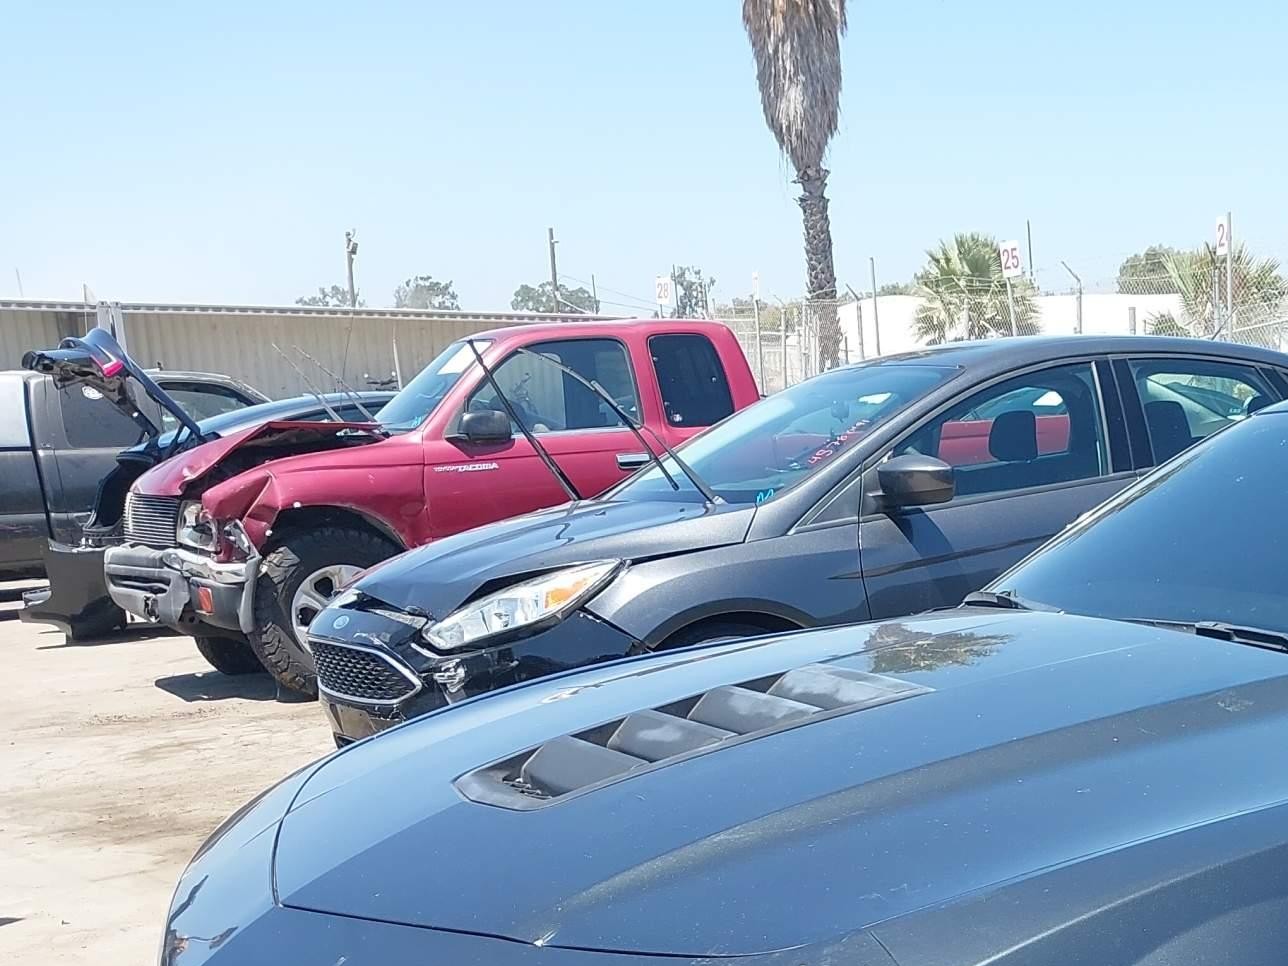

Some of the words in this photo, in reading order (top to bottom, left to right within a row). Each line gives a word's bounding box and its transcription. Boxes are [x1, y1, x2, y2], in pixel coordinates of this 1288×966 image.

[1217, 223, 1228, 248] 2
[1002, 247, 1020, 270] 25
[657, 282, 670, 299] 28
